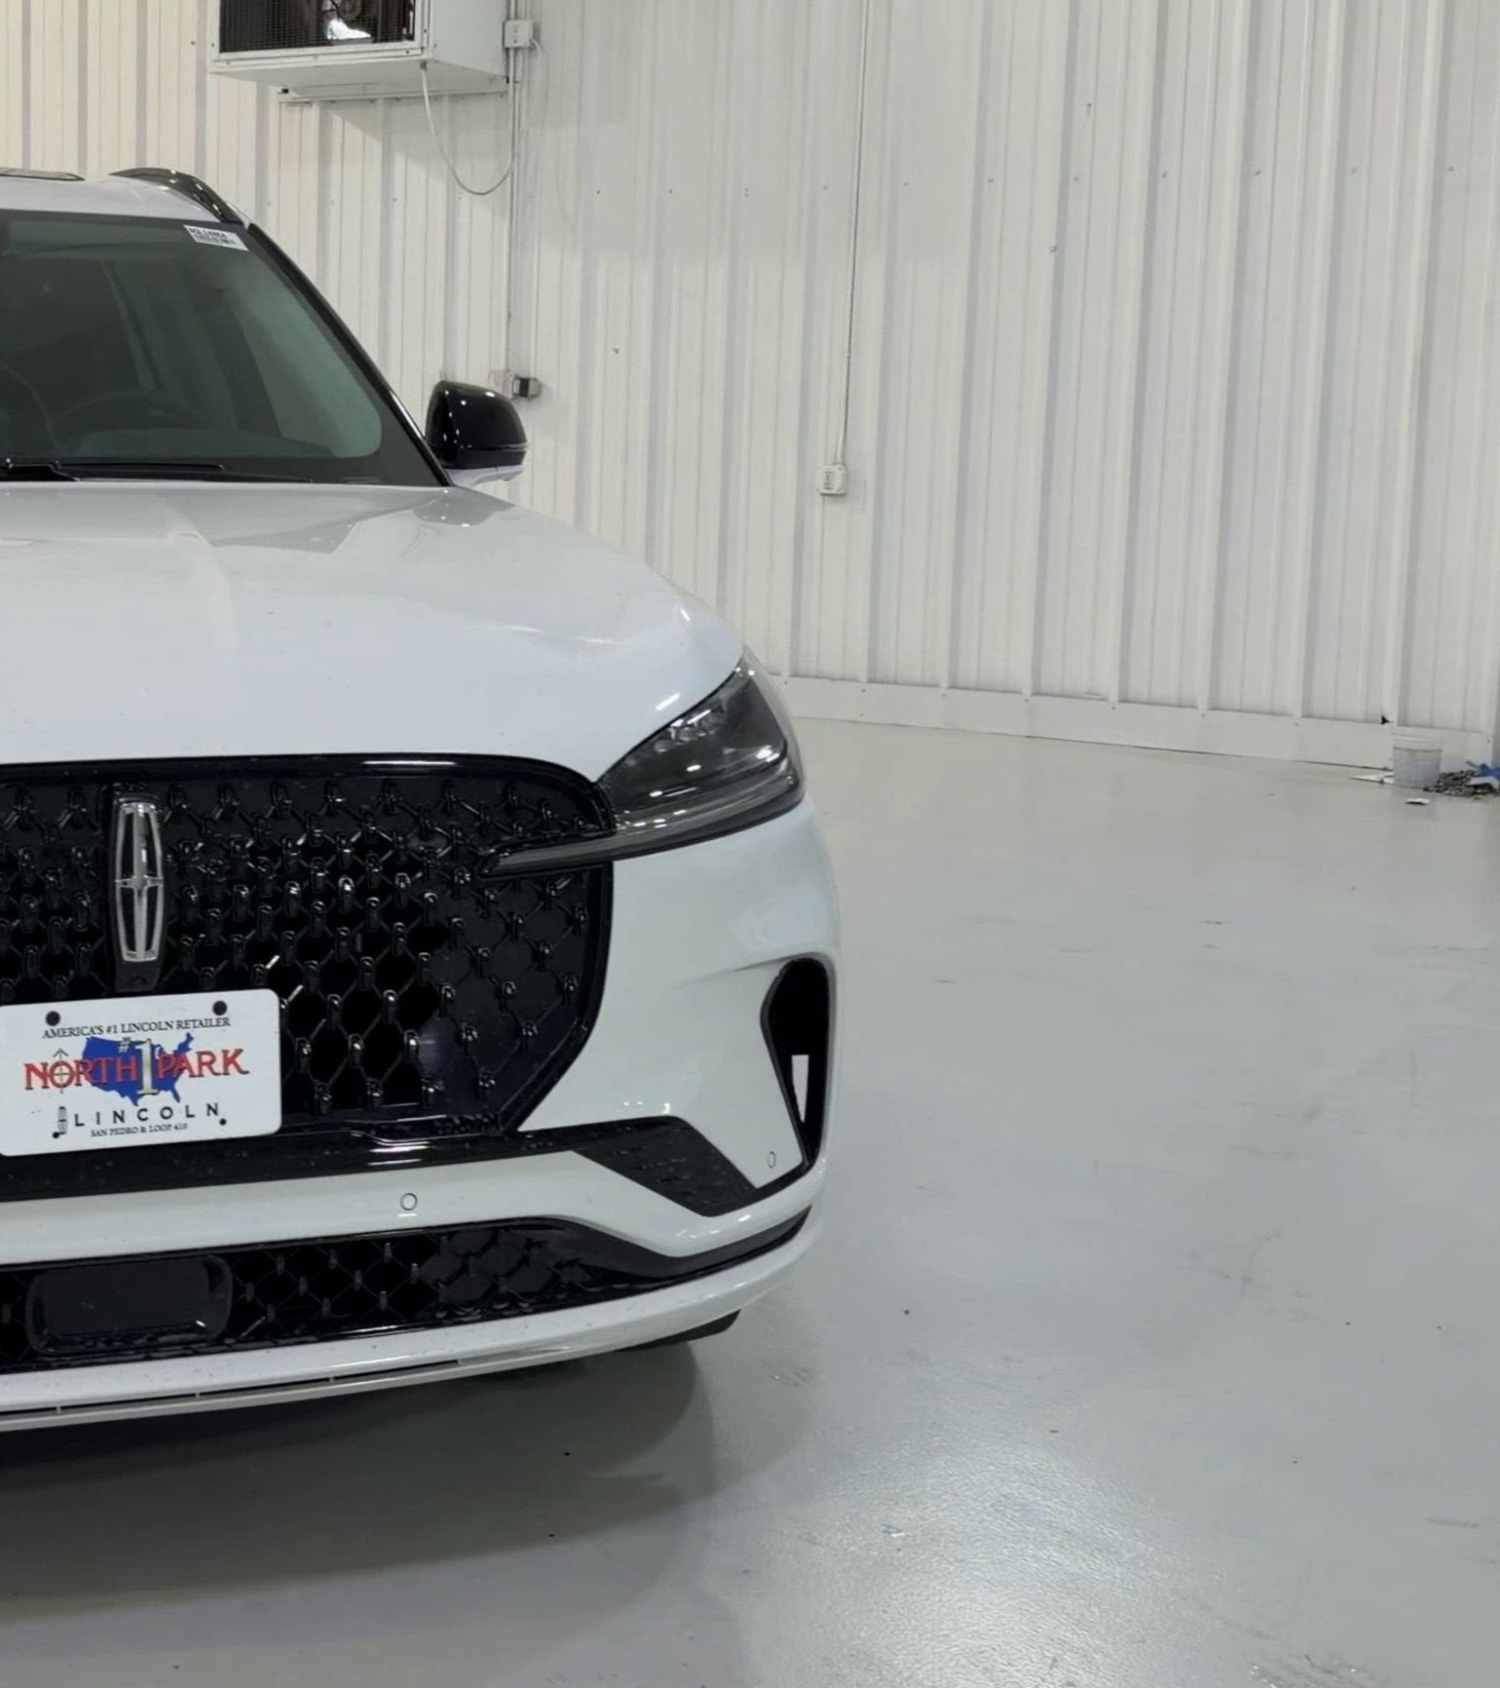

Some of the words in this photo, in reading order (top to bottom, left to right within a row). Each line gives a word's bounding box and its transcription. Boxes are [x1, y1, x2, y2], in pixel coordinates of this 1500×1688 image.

[42, 1024, 104, 1039] AMERICA'S
[106, 1024, 118, 1034] #1
[121, 1020, 174, 1033] LINCOLN
[176, 1017, 231, 1030] RETAILER
[24, 1056, 139, 1090] NORTH
[157, 1048, 250, 1078] PARK
[74, 1102, 220, 1127] LINCOLN
[91, 1129, 108, 1137] SAN
[110, 1127, 138, 1136] PEDRO
[149, 1124, 173, 1133] LOOP
